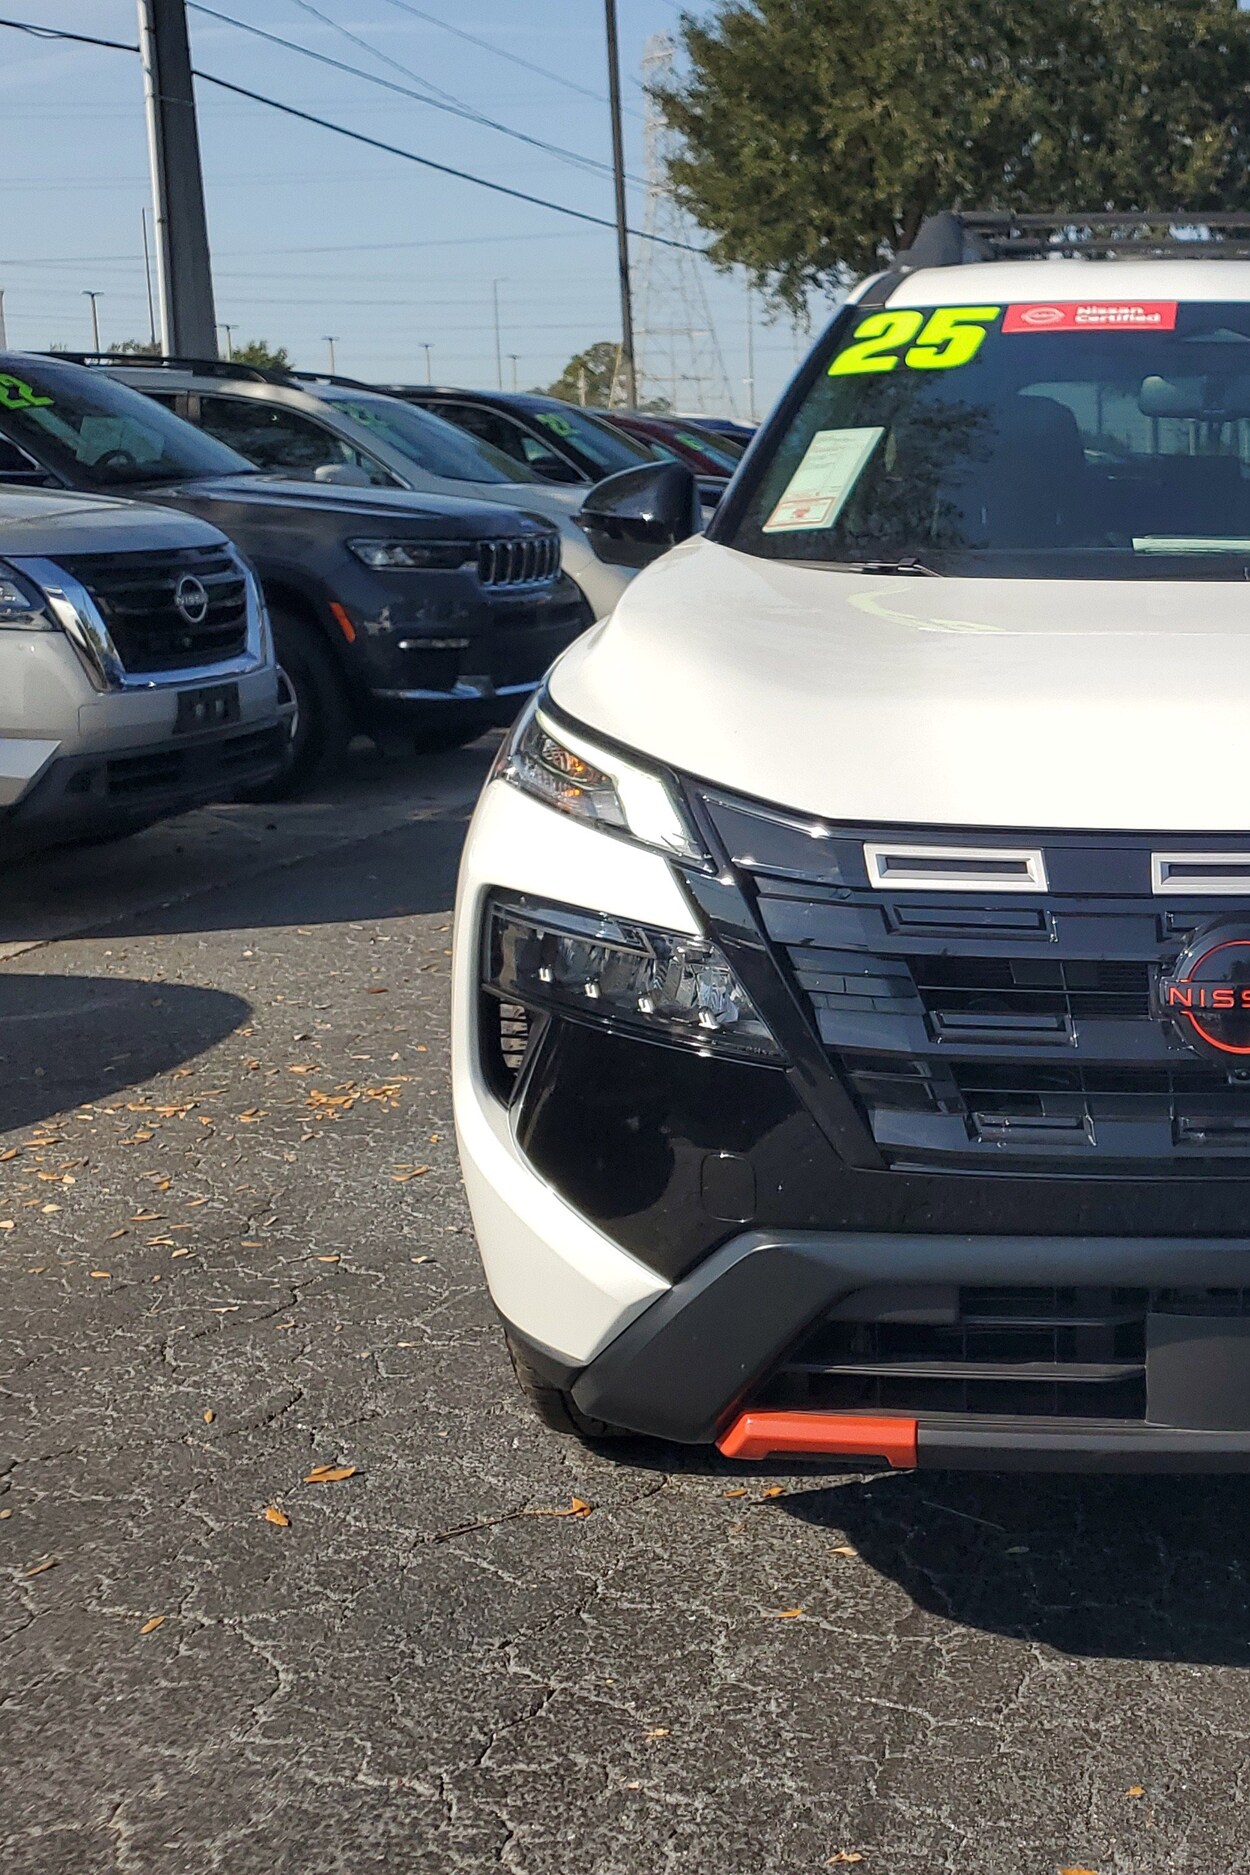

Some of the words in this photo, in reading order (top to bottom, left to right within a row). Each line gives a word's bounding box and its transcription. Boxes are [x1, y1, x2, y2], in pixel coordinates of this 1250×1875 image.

[1076, 305, 1144, 315] Nissan
[1074, 313, 1161, 323] Certified
[827, 305, 1001, 376] 25
